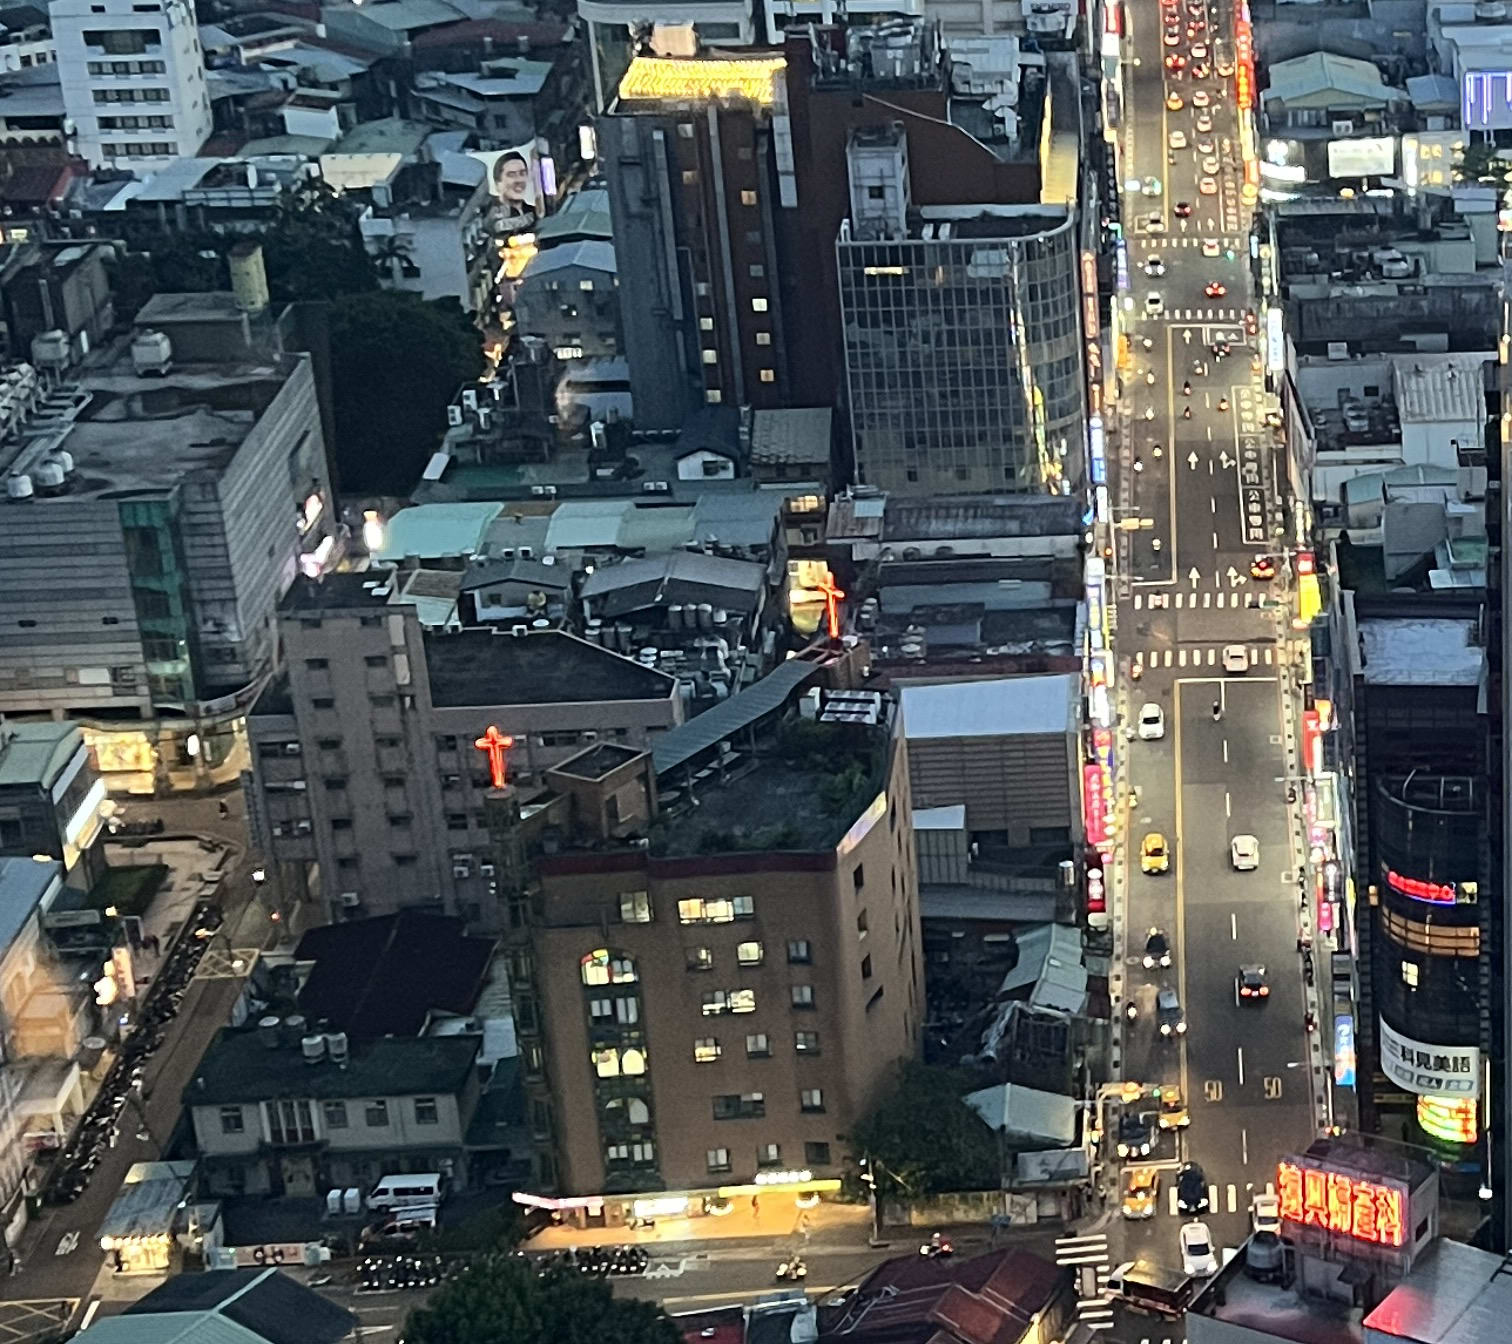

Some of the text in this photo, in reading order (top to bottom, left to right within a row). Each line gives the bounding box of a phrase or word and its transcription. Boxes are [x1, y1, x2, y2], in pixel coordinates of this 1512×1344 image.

[1400, 1044, 1471, 1073] 科見美語
[1204, 1079, 1223, 1102] 50
[1263, 1076, 1282, 1100] 50
